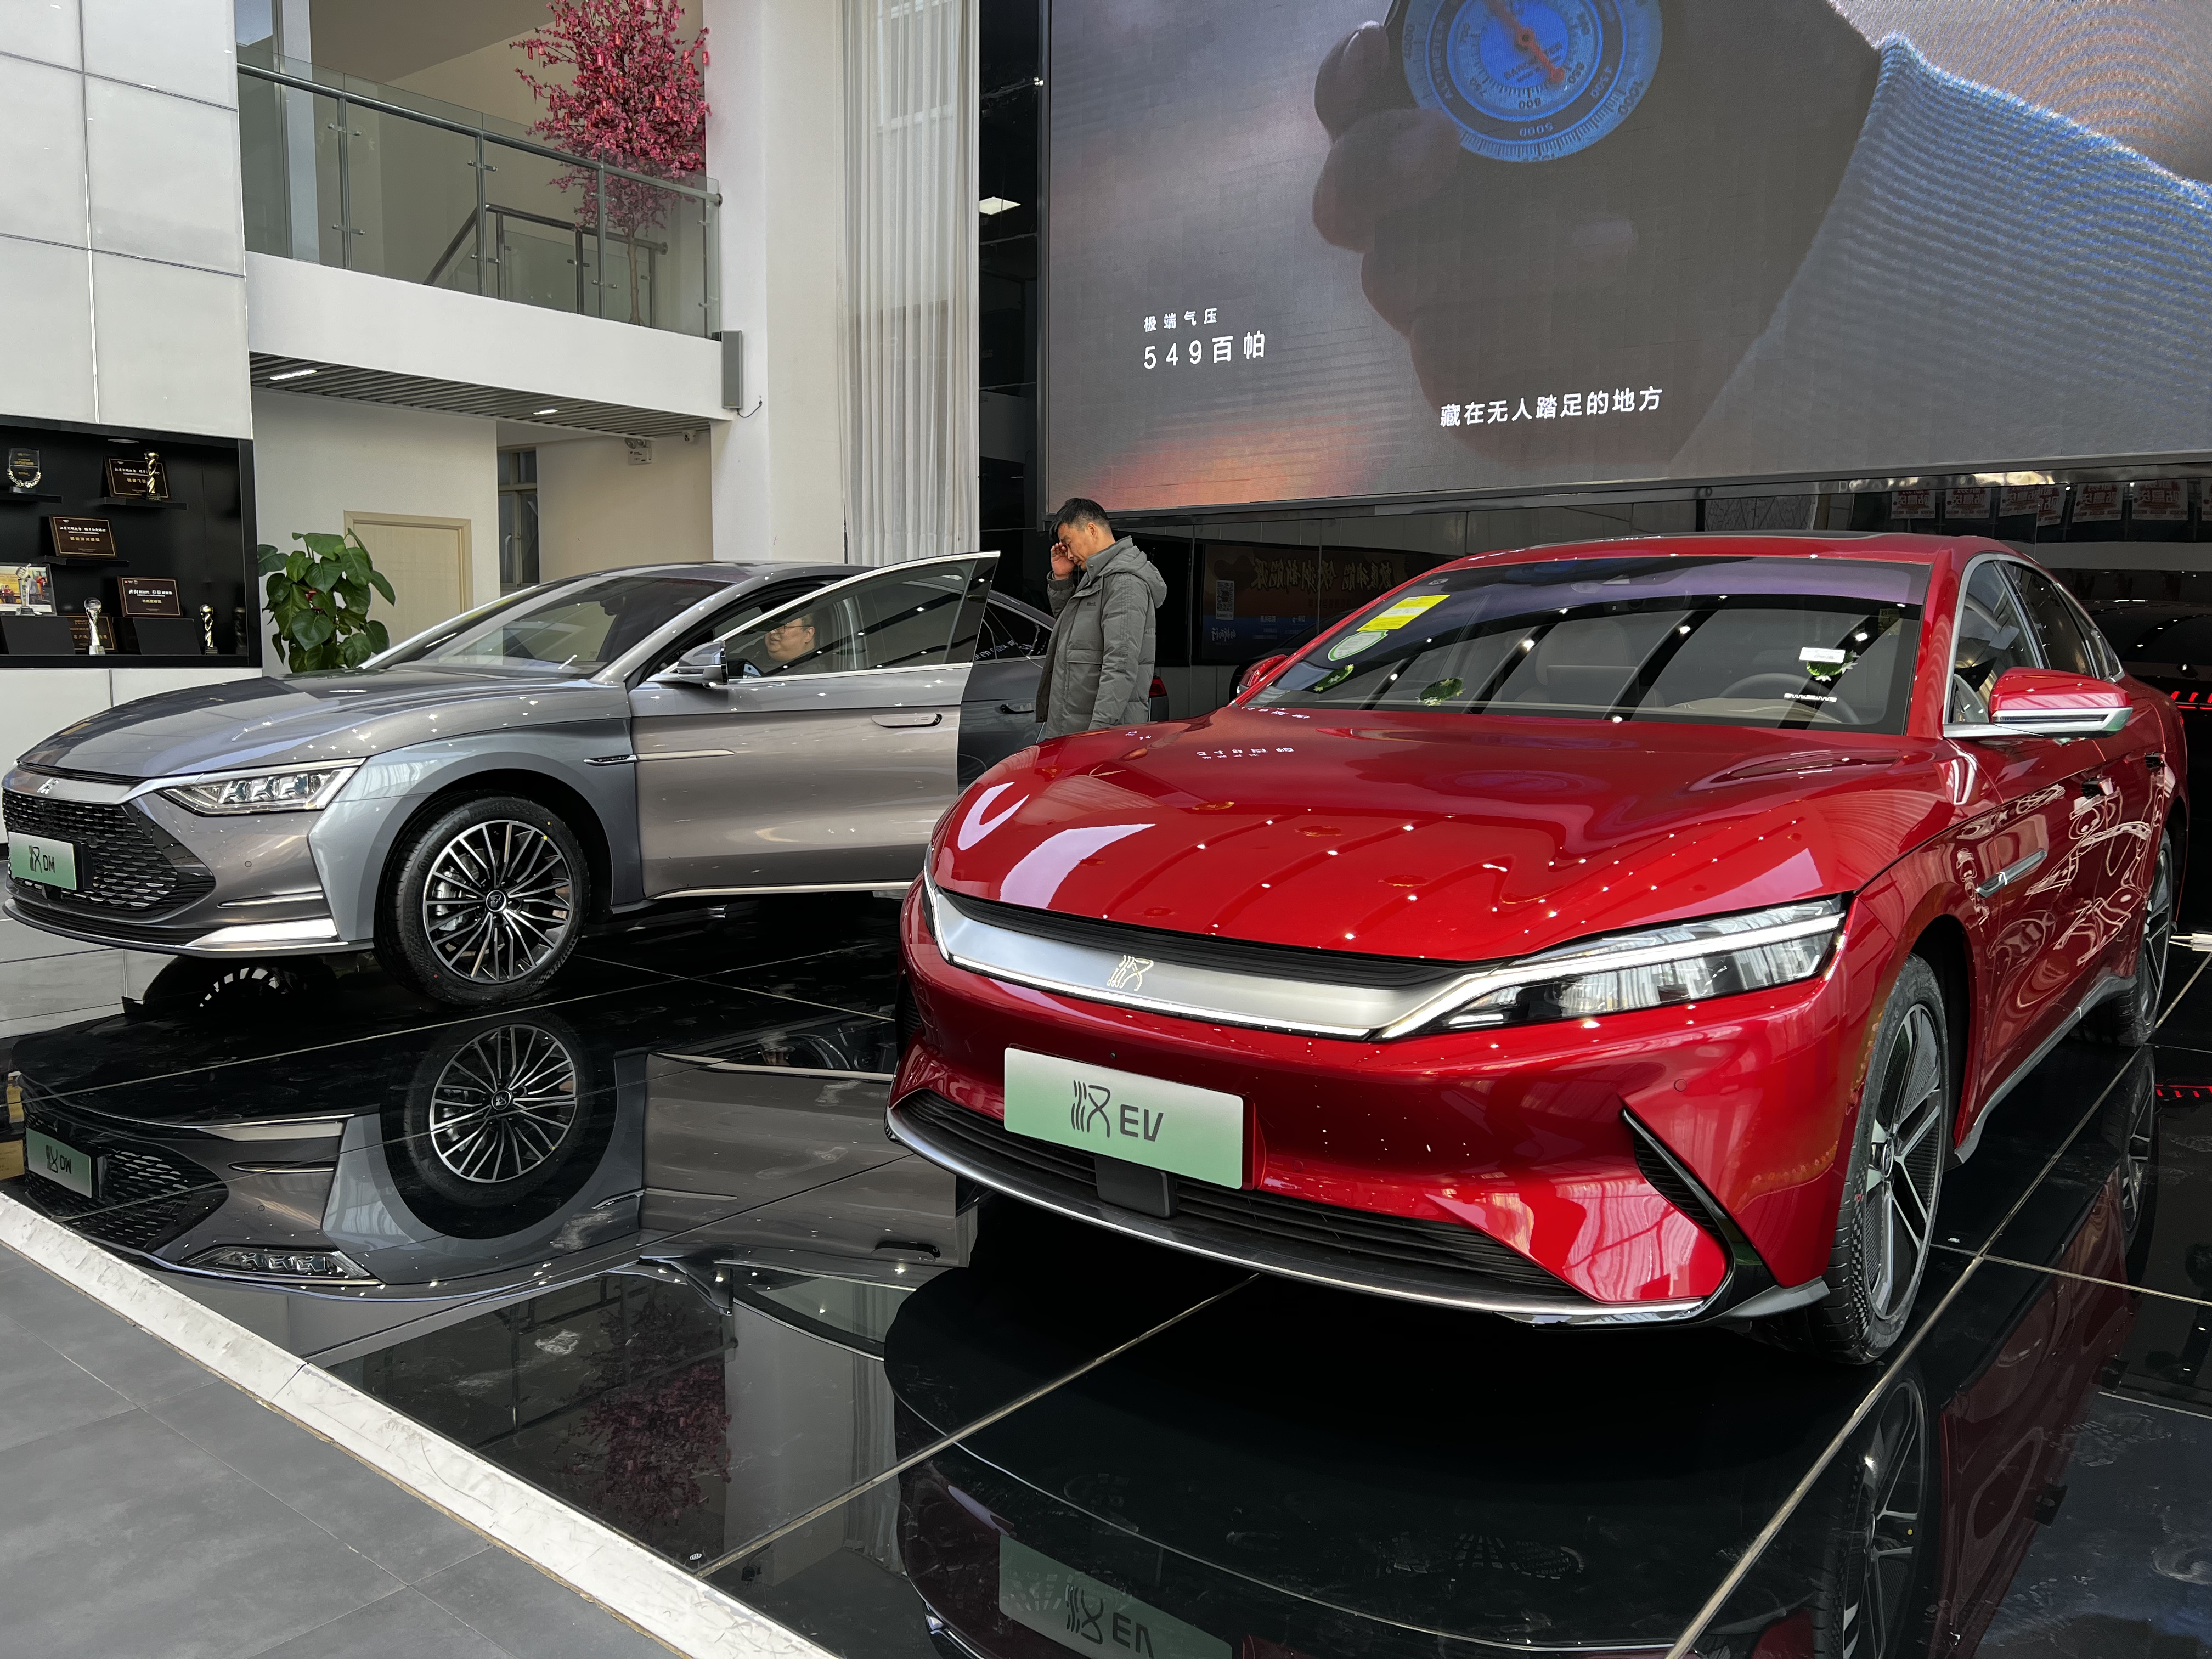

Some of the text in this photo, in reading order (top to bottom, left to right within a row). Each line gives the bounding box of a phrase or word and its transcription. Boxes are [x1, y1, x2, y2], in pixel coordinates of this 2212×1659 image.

[1519, 122, 1554, 137] 5000
[1144, 307, 1217, 332] 极端气压
[1144, 330, 1265, 369] 549百帕
[1440, 385, 1663, 427] 藏在无人踏足的地方
[42, 854, 55, 873] DM
[1120, 1103, 1164, 1142] EV
